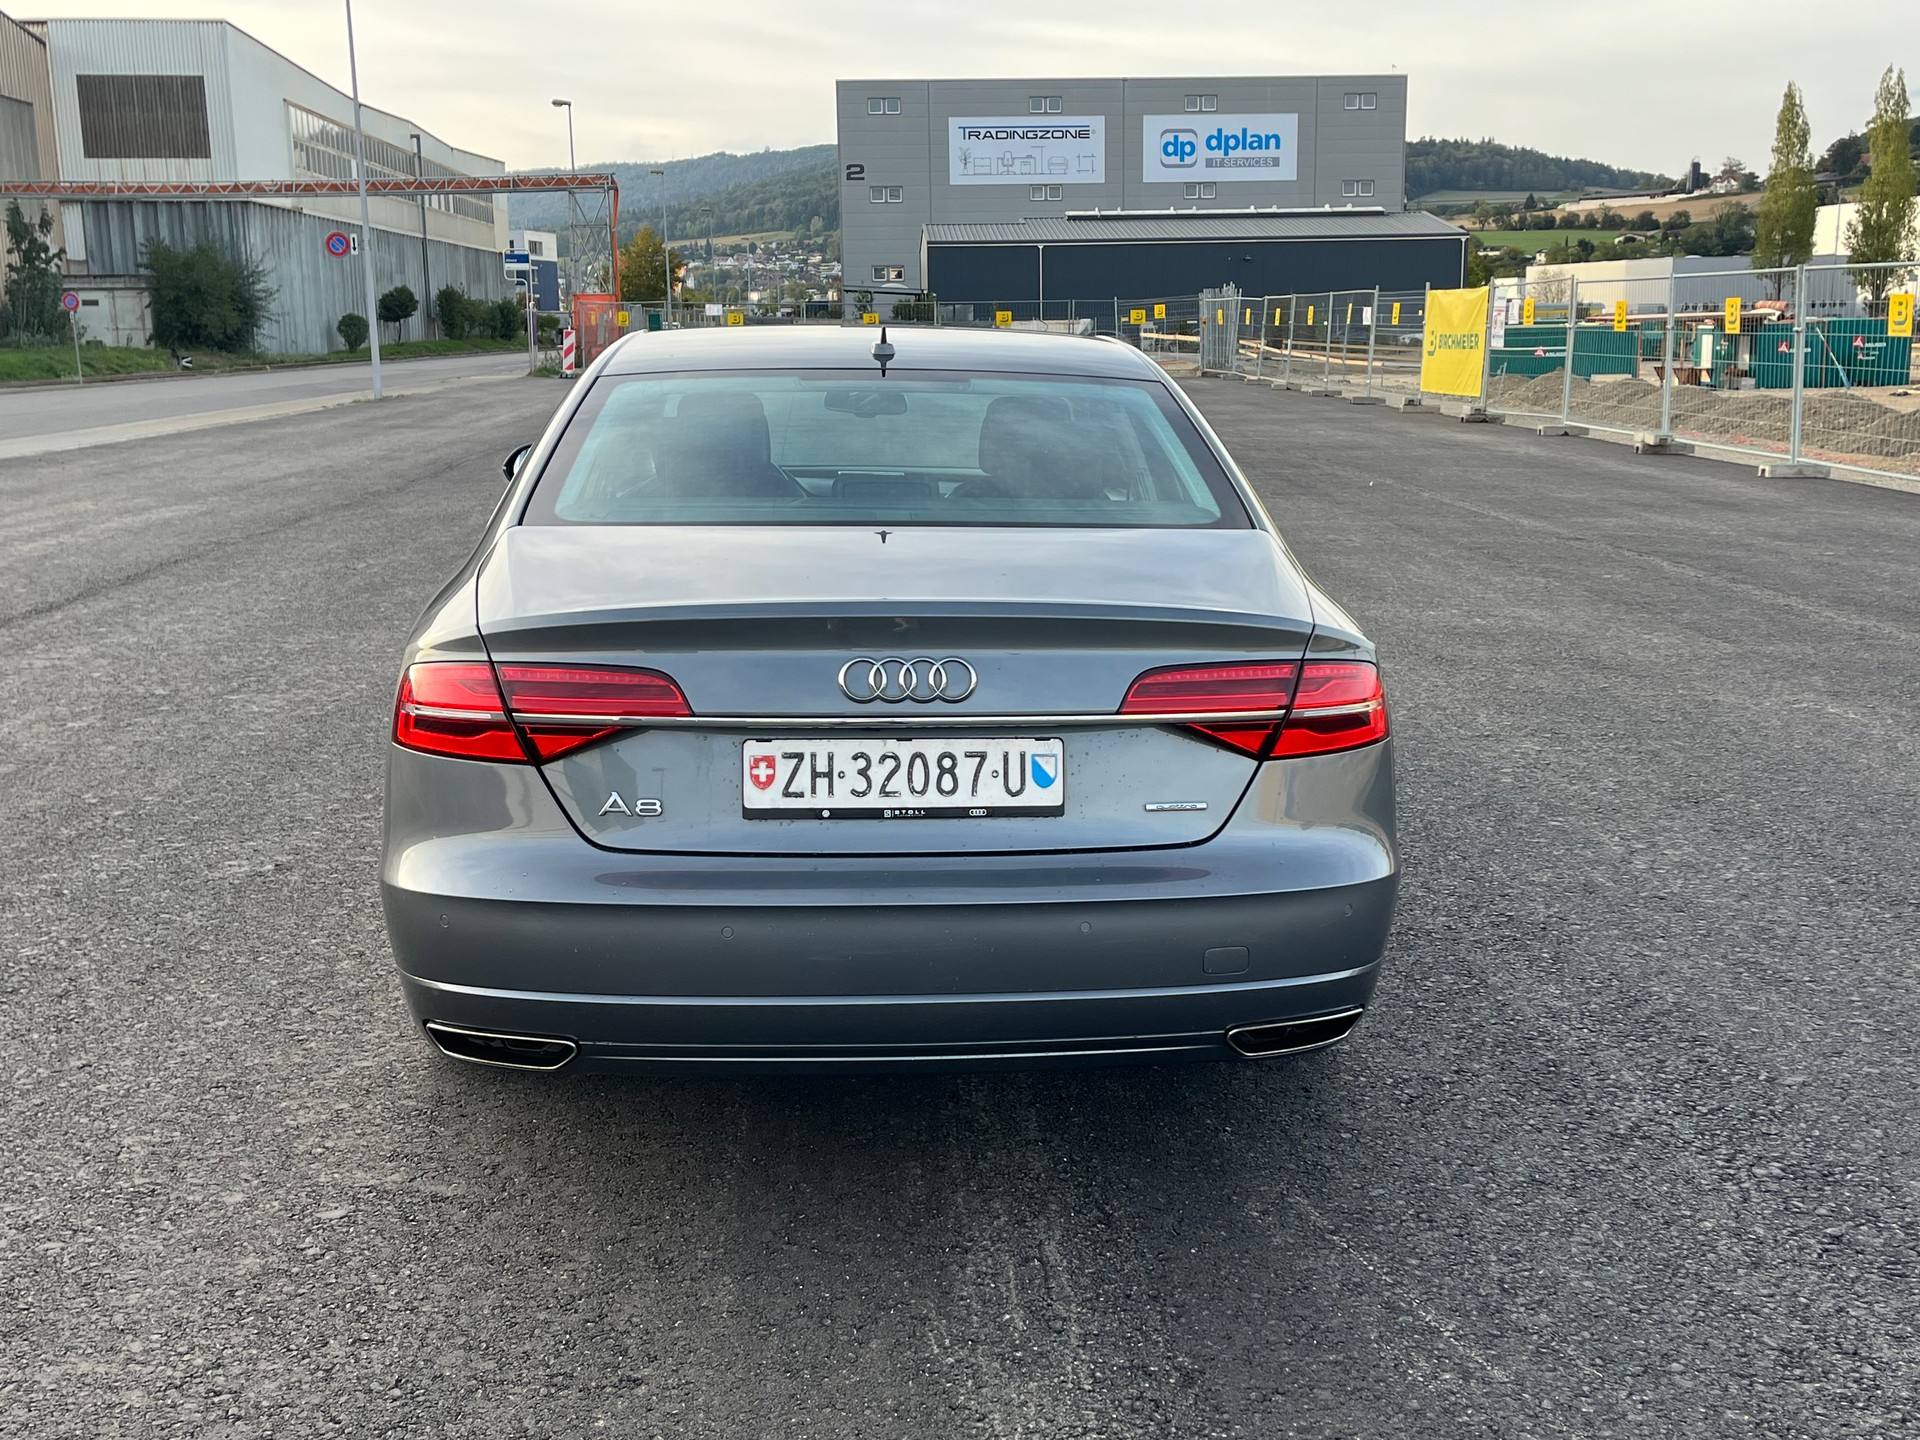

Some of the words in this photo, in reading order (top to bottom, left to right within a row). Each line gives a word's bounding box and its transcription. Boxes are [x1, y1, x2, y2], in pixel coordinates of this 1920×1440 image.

[1162, 134, 1196, 163] dp
[1205, 127, 1281, 157] dplan
[846, 163, 865, 181] 2
[1212, 158, 1222, 167] IT
[1223, 158, 1274, 167] SERVICES
[1438, 333, 1480, 350] BIRCHMEIER
[598, 791, 663, 817] A8
